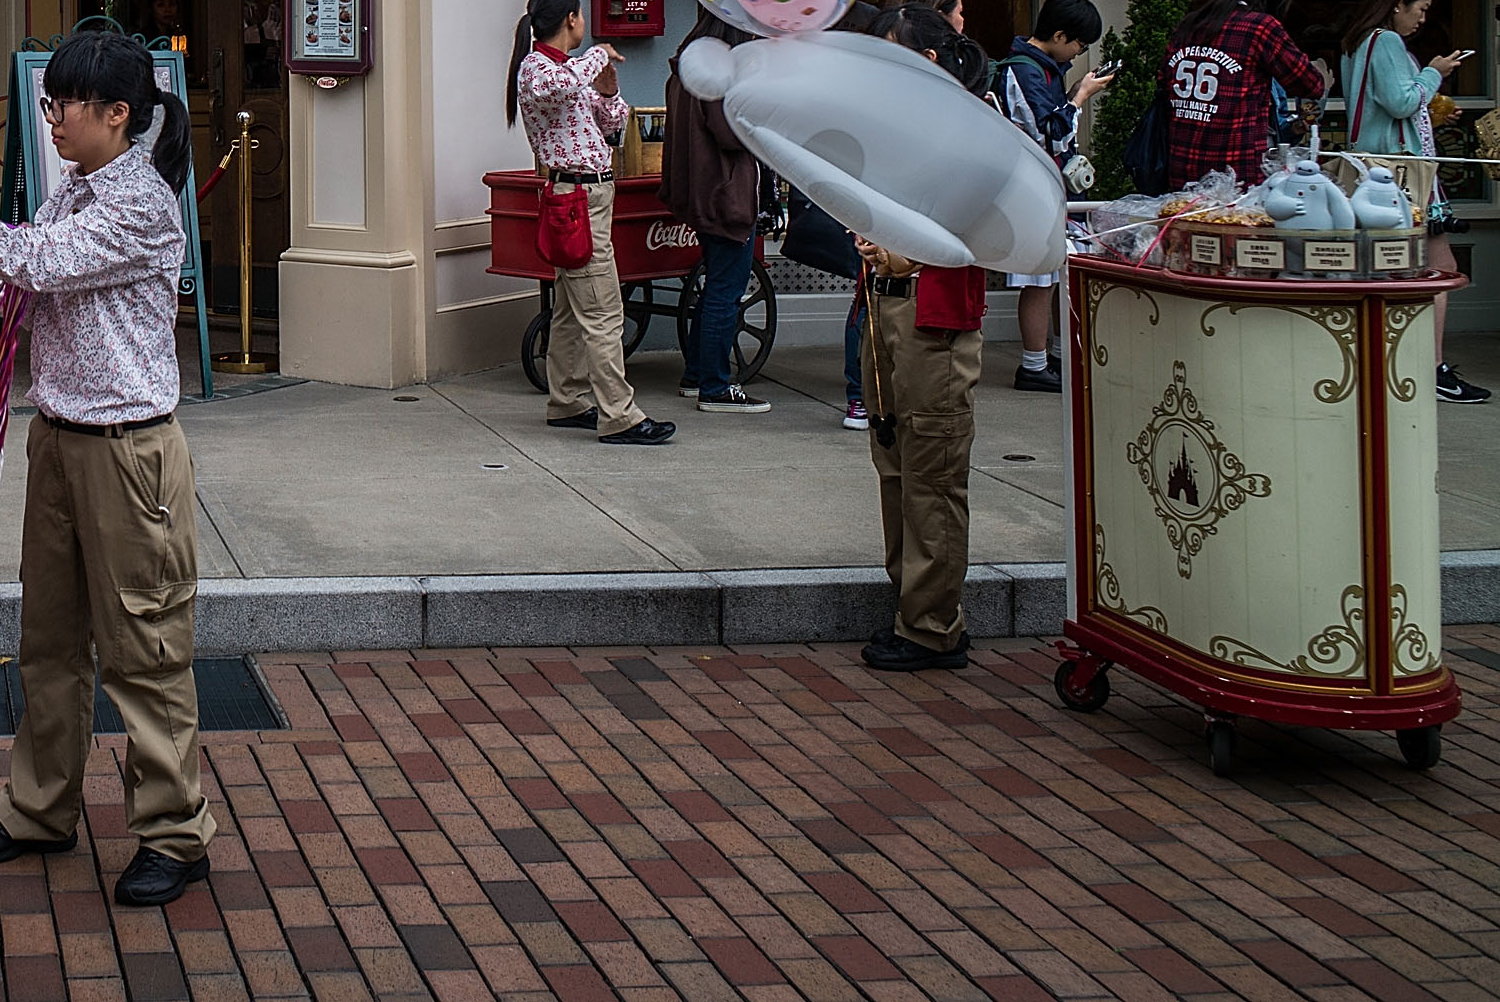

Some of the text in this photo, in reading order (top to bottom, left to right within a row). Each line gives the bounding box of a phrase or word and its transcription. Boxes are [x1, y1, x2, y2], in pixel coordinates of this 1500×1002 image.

[1168, 46, 1243, 74] NEW PERSPECTIVE
[1173, 60, 1219, 101] 56
[1185, 110, 1202, 120] OVER
[1190, 101, 1208, 112] HAVE
[1209, 105, 1218, 113] TO
